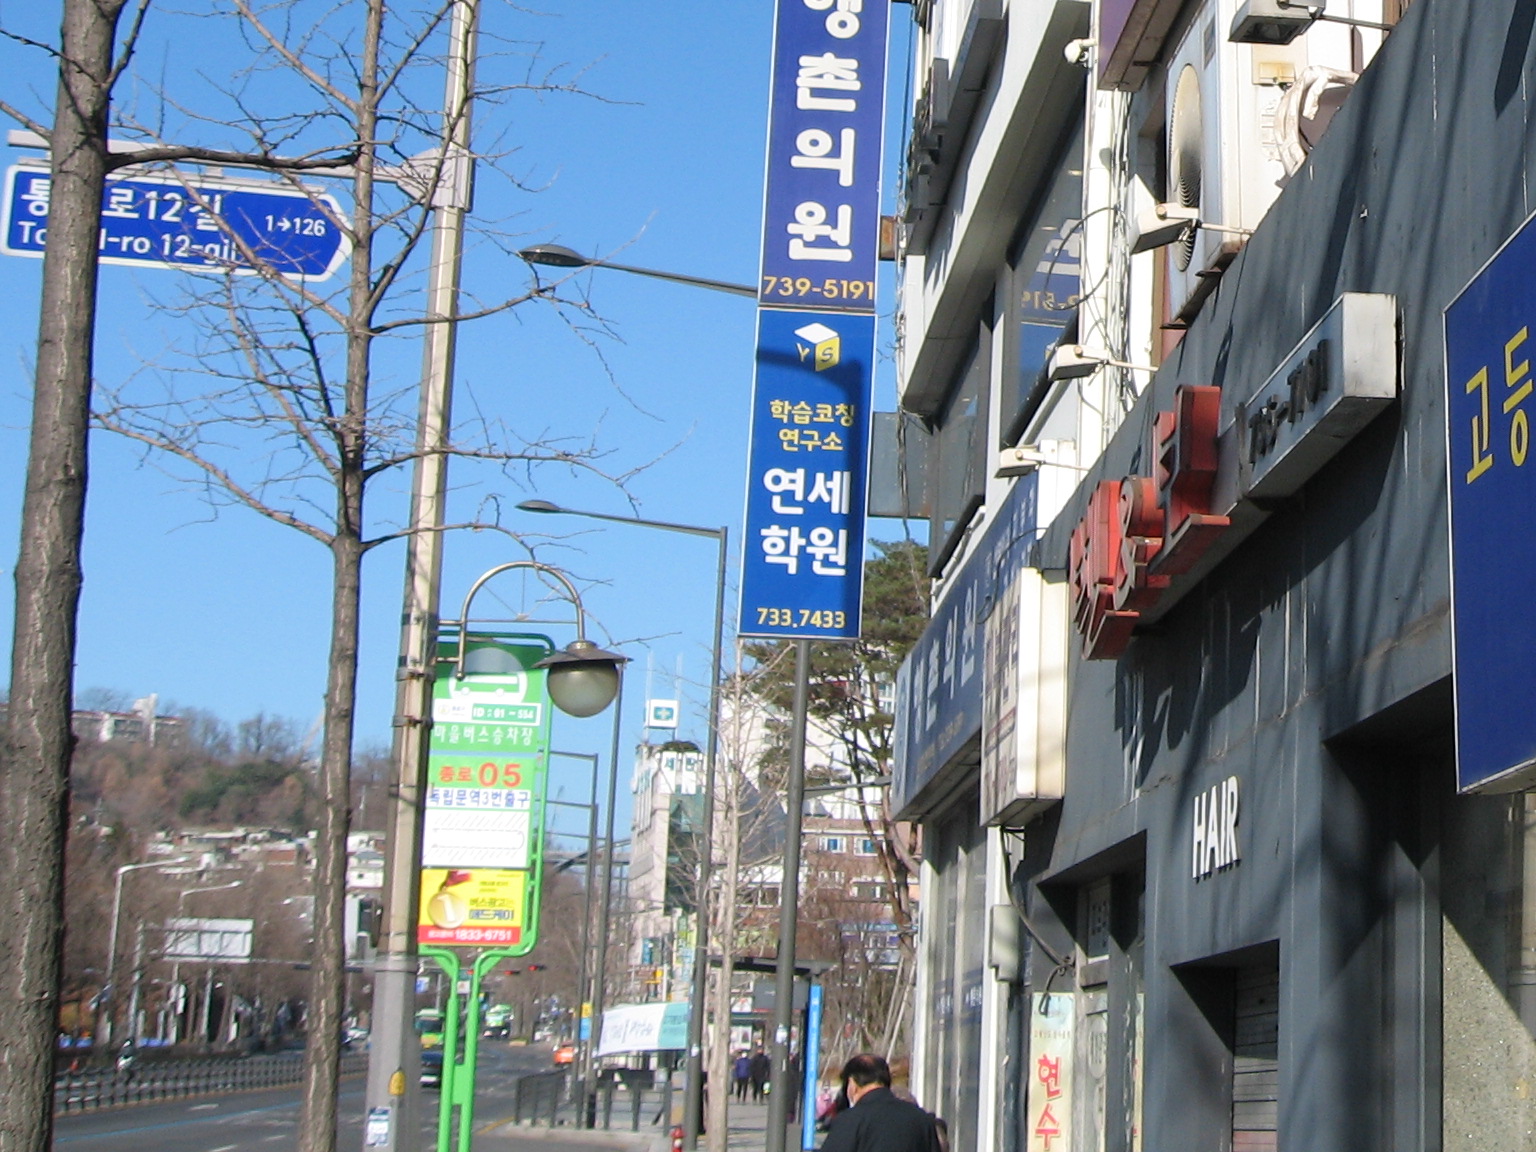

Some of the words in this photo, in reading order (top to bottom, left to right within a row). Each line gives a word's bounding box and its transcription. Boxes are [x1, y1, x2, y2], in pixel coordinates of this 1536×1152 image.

[20, 178, 222, 232] 통로12길
[17, 220, 150, 255] Tol-ro
[763, 275, 875, 301] 739-5191
[769, 399, 854, 427] 학습코칭
[778, 429, 844, 452] 연구소
[763, 467, 852, 515] 연세
[760, 524, 848, 577] 학원
[756, 607, 846, 629] 733.7433
[439, 765, 473, 783] 종로
[478, 762, 522, 788] 05
[1192, 776, 1239, 879] HAIR
